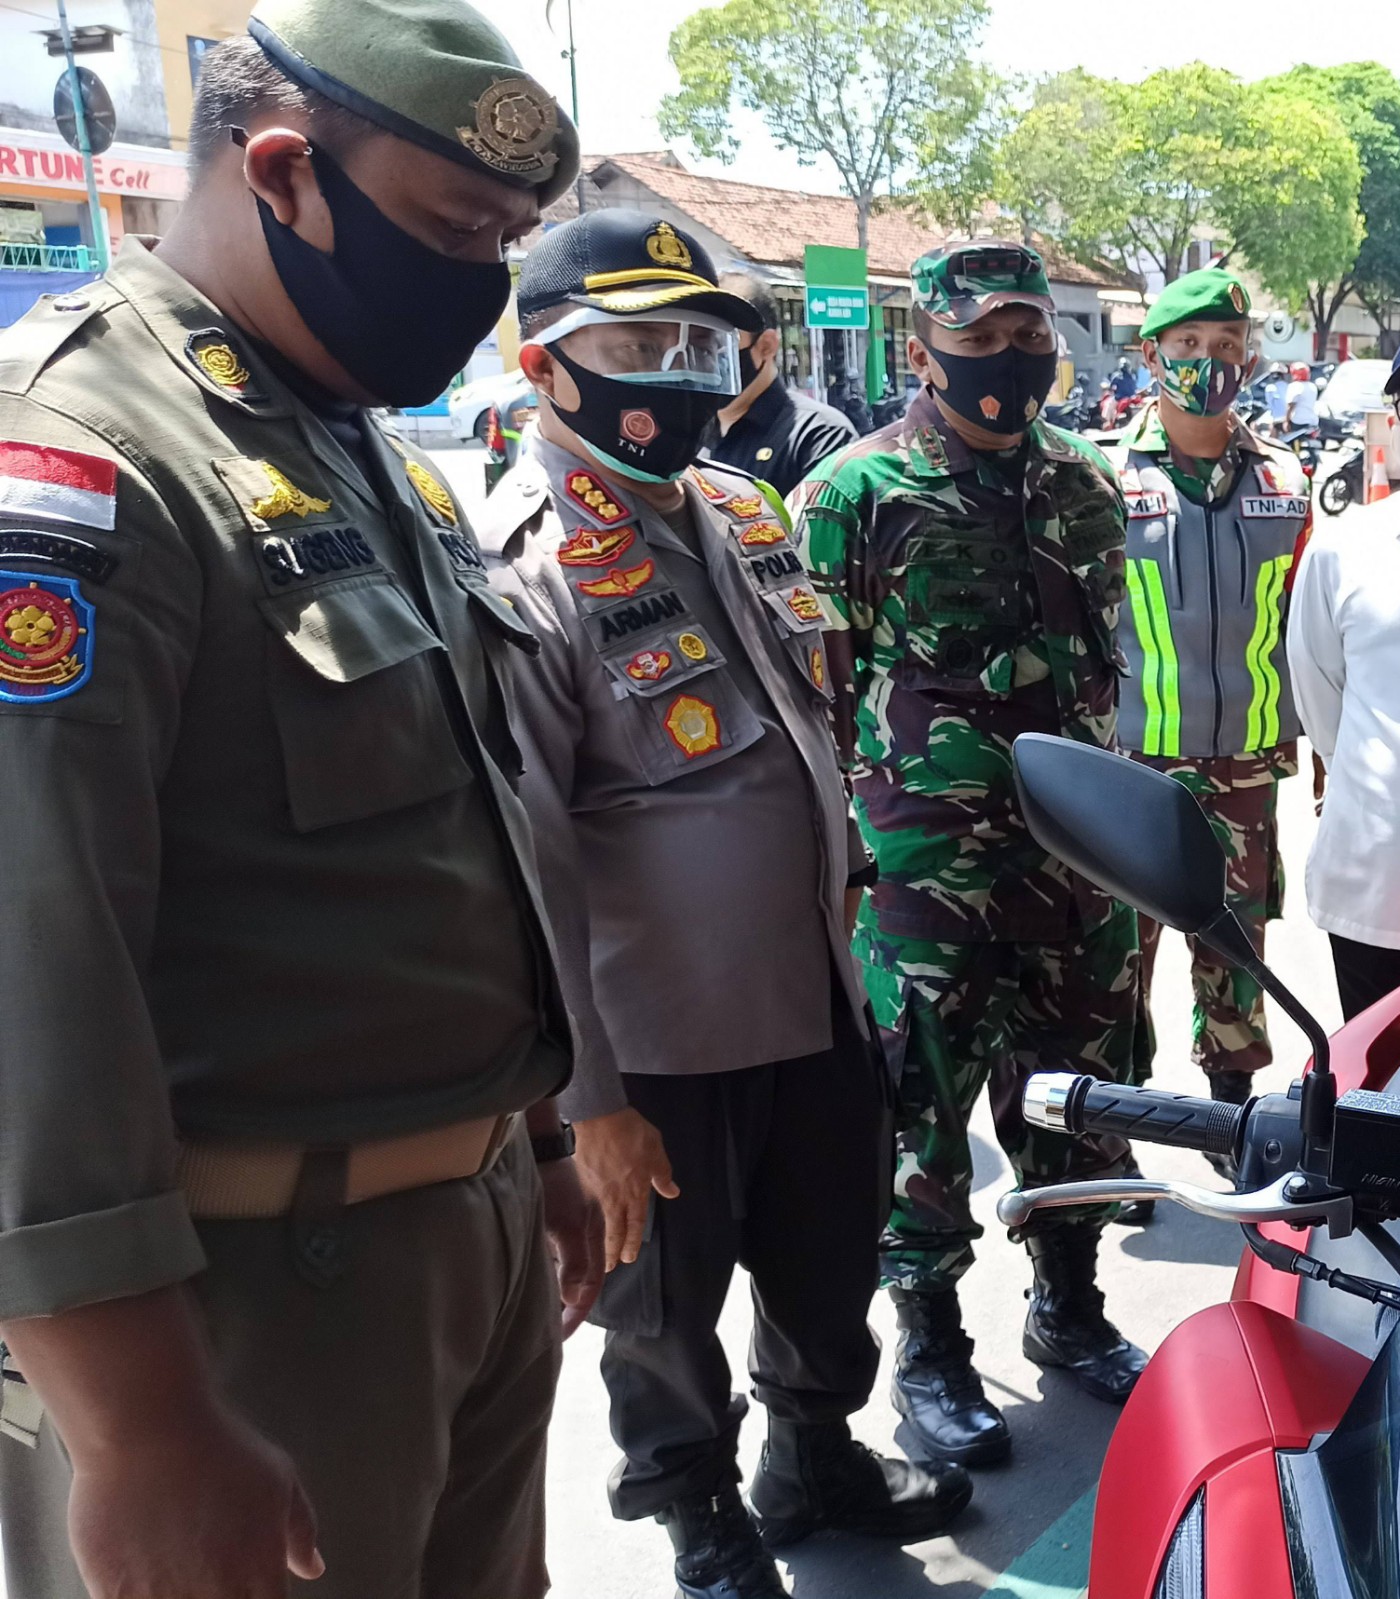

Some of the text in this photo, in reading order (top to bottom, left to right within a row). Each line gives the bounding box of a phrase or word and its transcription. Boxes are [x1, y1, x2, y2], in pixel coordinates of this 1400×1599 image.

[109, 167, 151, 190] Cell
[618, 437, 646, 457] TNI
[1245, 500, 1306, 515] TNI-AD
[263, 526, 376, 586] SUGENG
[602, 591, 686, 642] ARMAN
